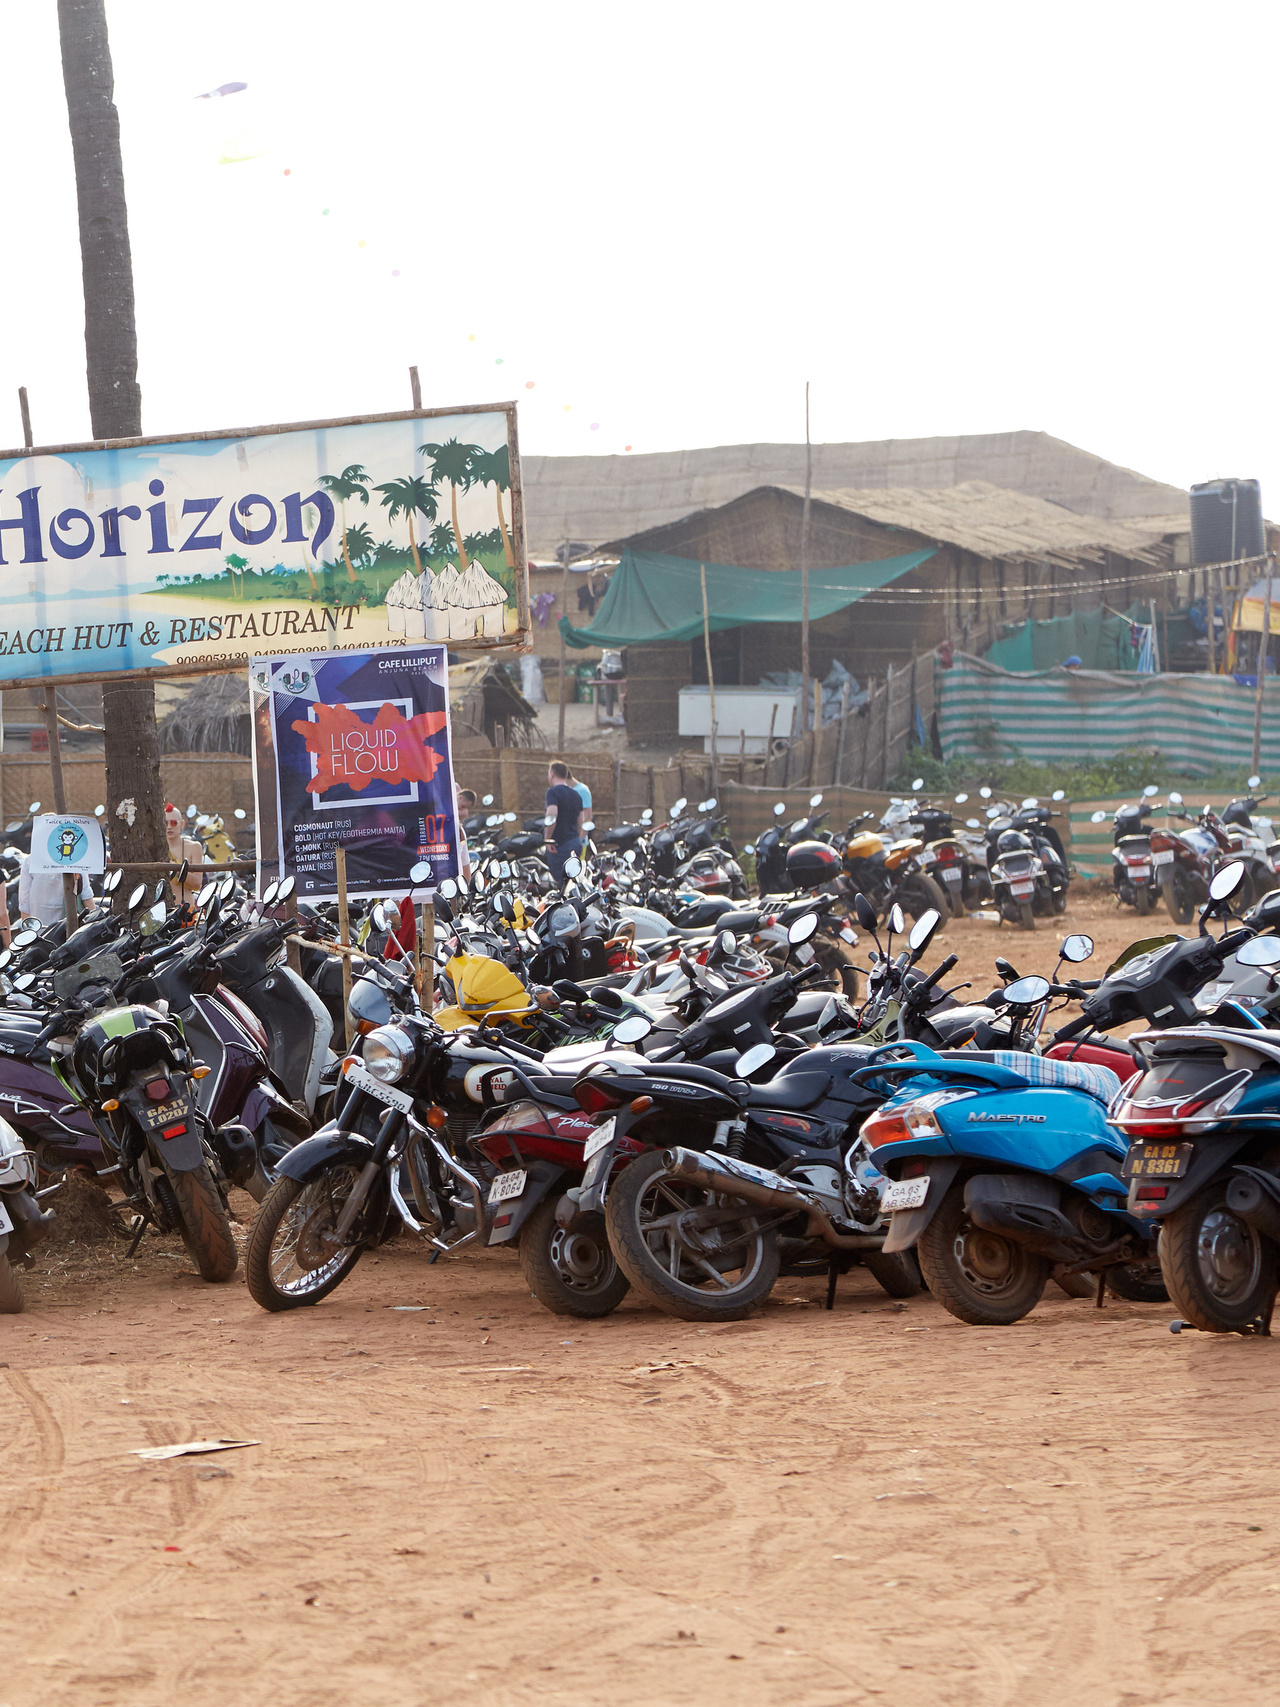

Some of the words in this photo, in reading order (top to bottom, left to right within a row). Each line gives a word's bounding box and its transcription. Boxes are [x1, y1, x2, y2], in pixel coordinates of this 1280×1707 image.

[71, 622, 134, 652] HUT
[138, 621, 161, 647] &
[167, 604, 361, 645] RESTAURANT
[378, 659, 400, 669] CAFE
[401, 656, 438, 667] LILLIPUT
[330, 729, 397, 752] LIQUID
[332, 750, 399, 776] FLOW
[294, 821, 333, 832] COSMONAUT
[334, 819, 352, 829] (RUS)
[425, 814, 446, 844] 07
[294, 834, 311, 842] BOLD
[312, 832, 327, 842] (HOT
[295, 843, 322, 853] G-MONK
[322, 841, 340, 850] (RUS)
[419, 845, 448, 854] WEDNESDAY
[295, 853, 321, 862] DATURA
[321, 851, 337, 860] (RUS
[296, 863, 316, 873] RAVAL
[317, 861, 334, 871] (RES)
[147, 1098, 185, 1118] GA.11
[147, 1105, 189, 1127] T.0207
